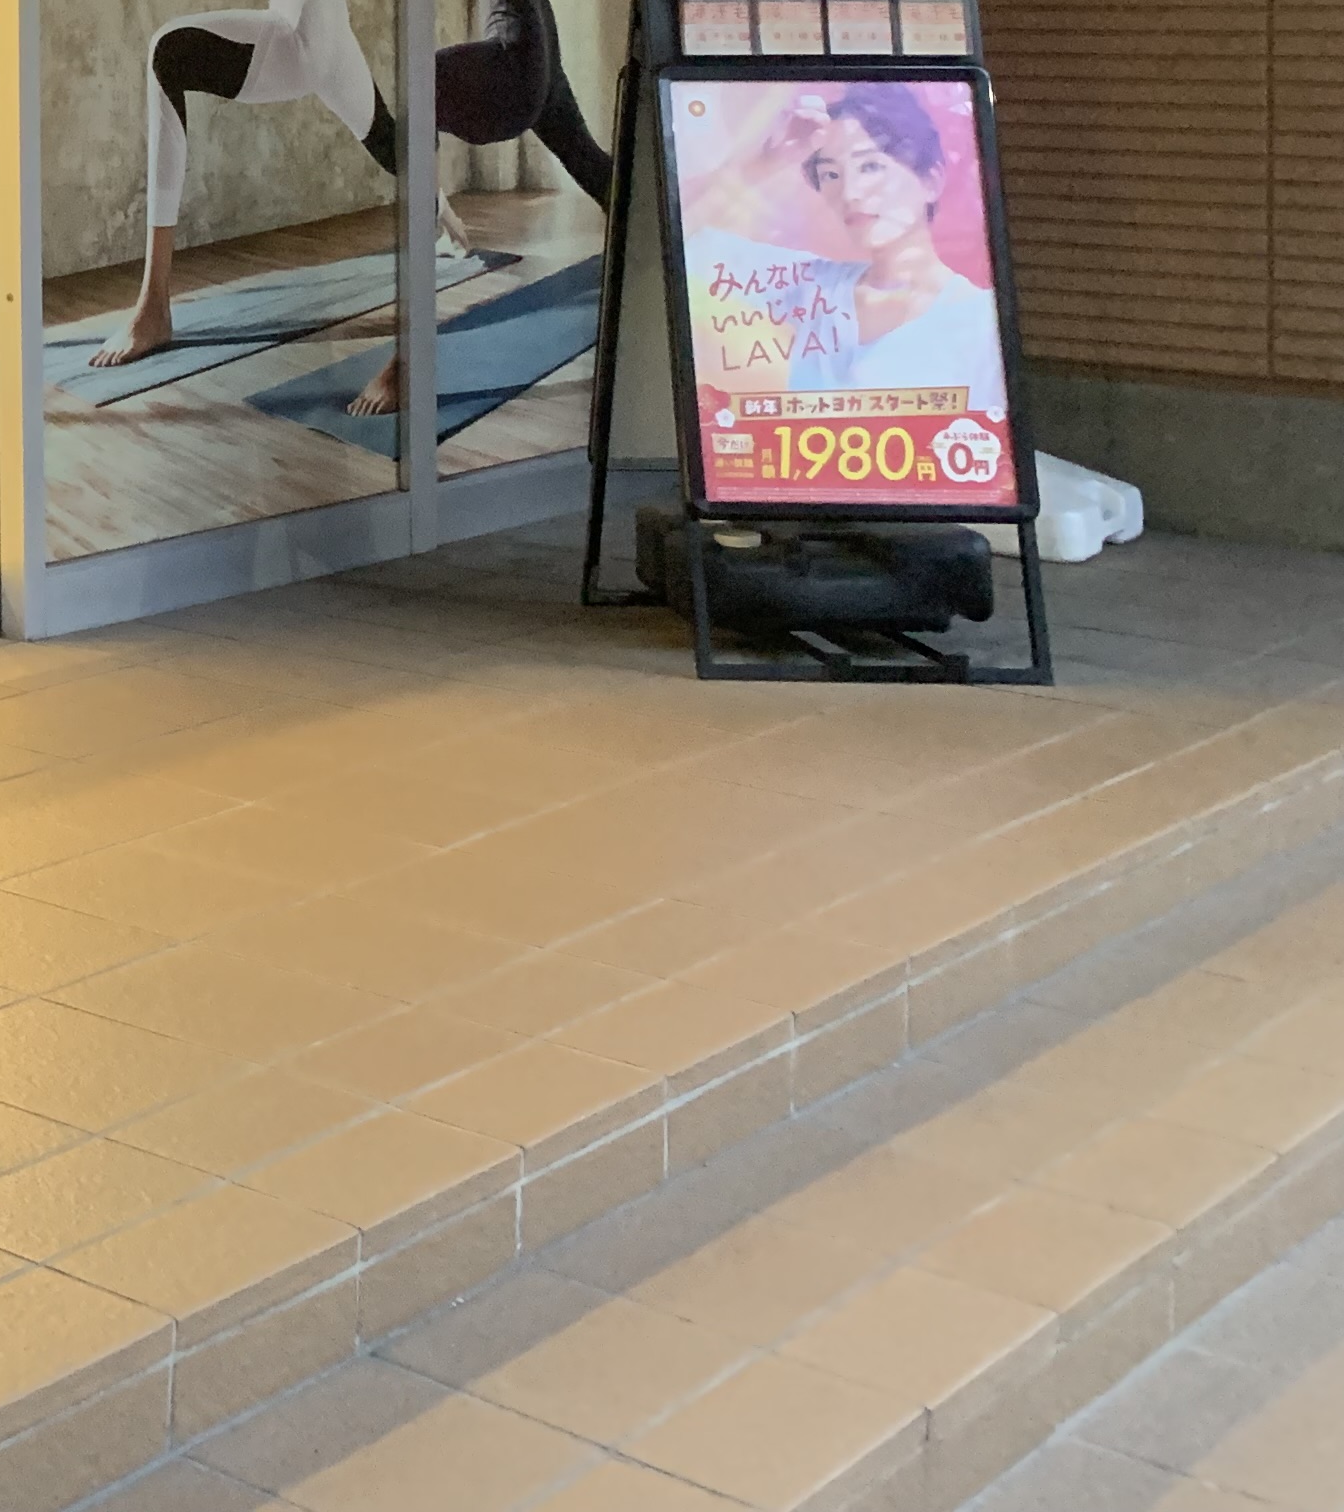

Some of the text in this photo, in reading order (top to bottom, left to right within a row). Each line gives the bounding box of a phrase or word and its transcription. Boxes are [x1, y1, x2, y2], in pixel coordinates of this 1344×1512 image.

[709, 262, 816, 302] みんなに
[711, 285, 851, 333] いいじゃん、
[722, 326, 840, 371] LAVA!
[744, 399, 779, 416] 新年
